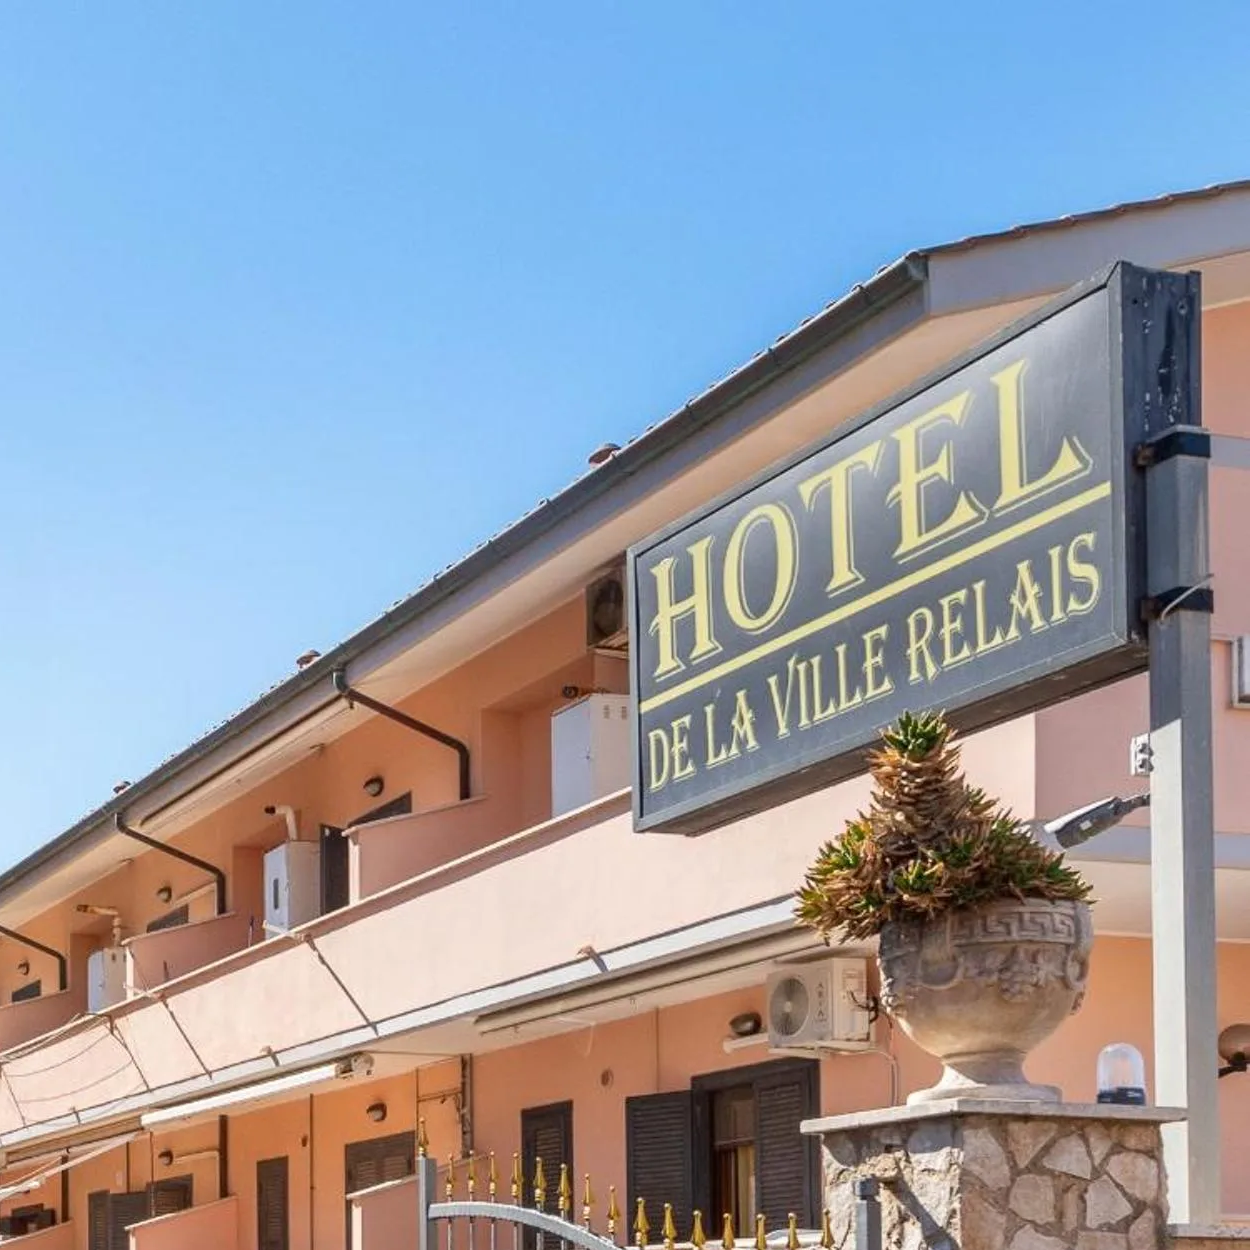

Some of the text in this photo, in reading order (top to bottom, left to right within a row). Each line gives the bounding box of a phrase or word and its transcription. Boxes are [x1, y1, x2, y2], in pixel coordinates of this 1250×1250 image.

[648, 531, 1102, 792] DE LA VILLE RELAIS
[649, 359, 1093, 681] HOTEL
